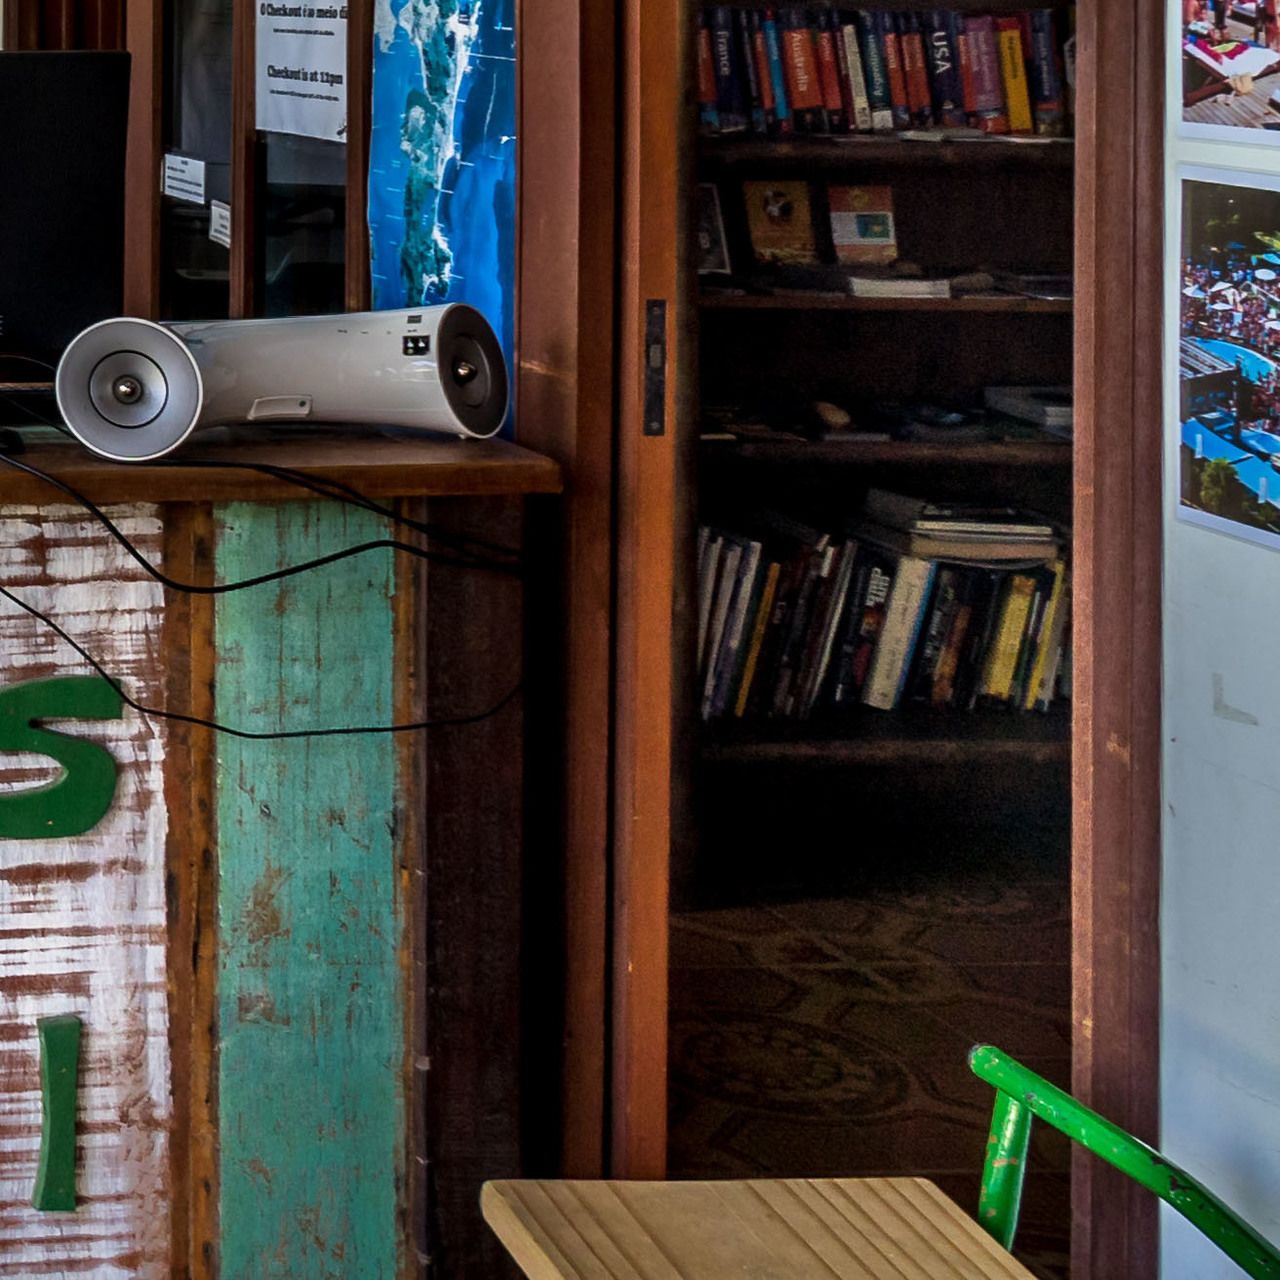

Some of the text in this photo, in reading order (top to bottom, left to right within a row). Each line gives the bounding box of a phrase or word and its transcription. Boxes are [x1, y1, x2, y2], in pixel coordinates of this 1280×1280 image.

[266, 3, 301, 17] Checkout
[316, 5, 338, 19] meio
[717, 31, 731, 76] France
[791, 33, 809, 92] Australia
[932, 31, 951, 74] USA
[267, 65, 301, 80] Checkout
[309, 70, 318, 82] at
[319, 72, 343, 87] 12pm
